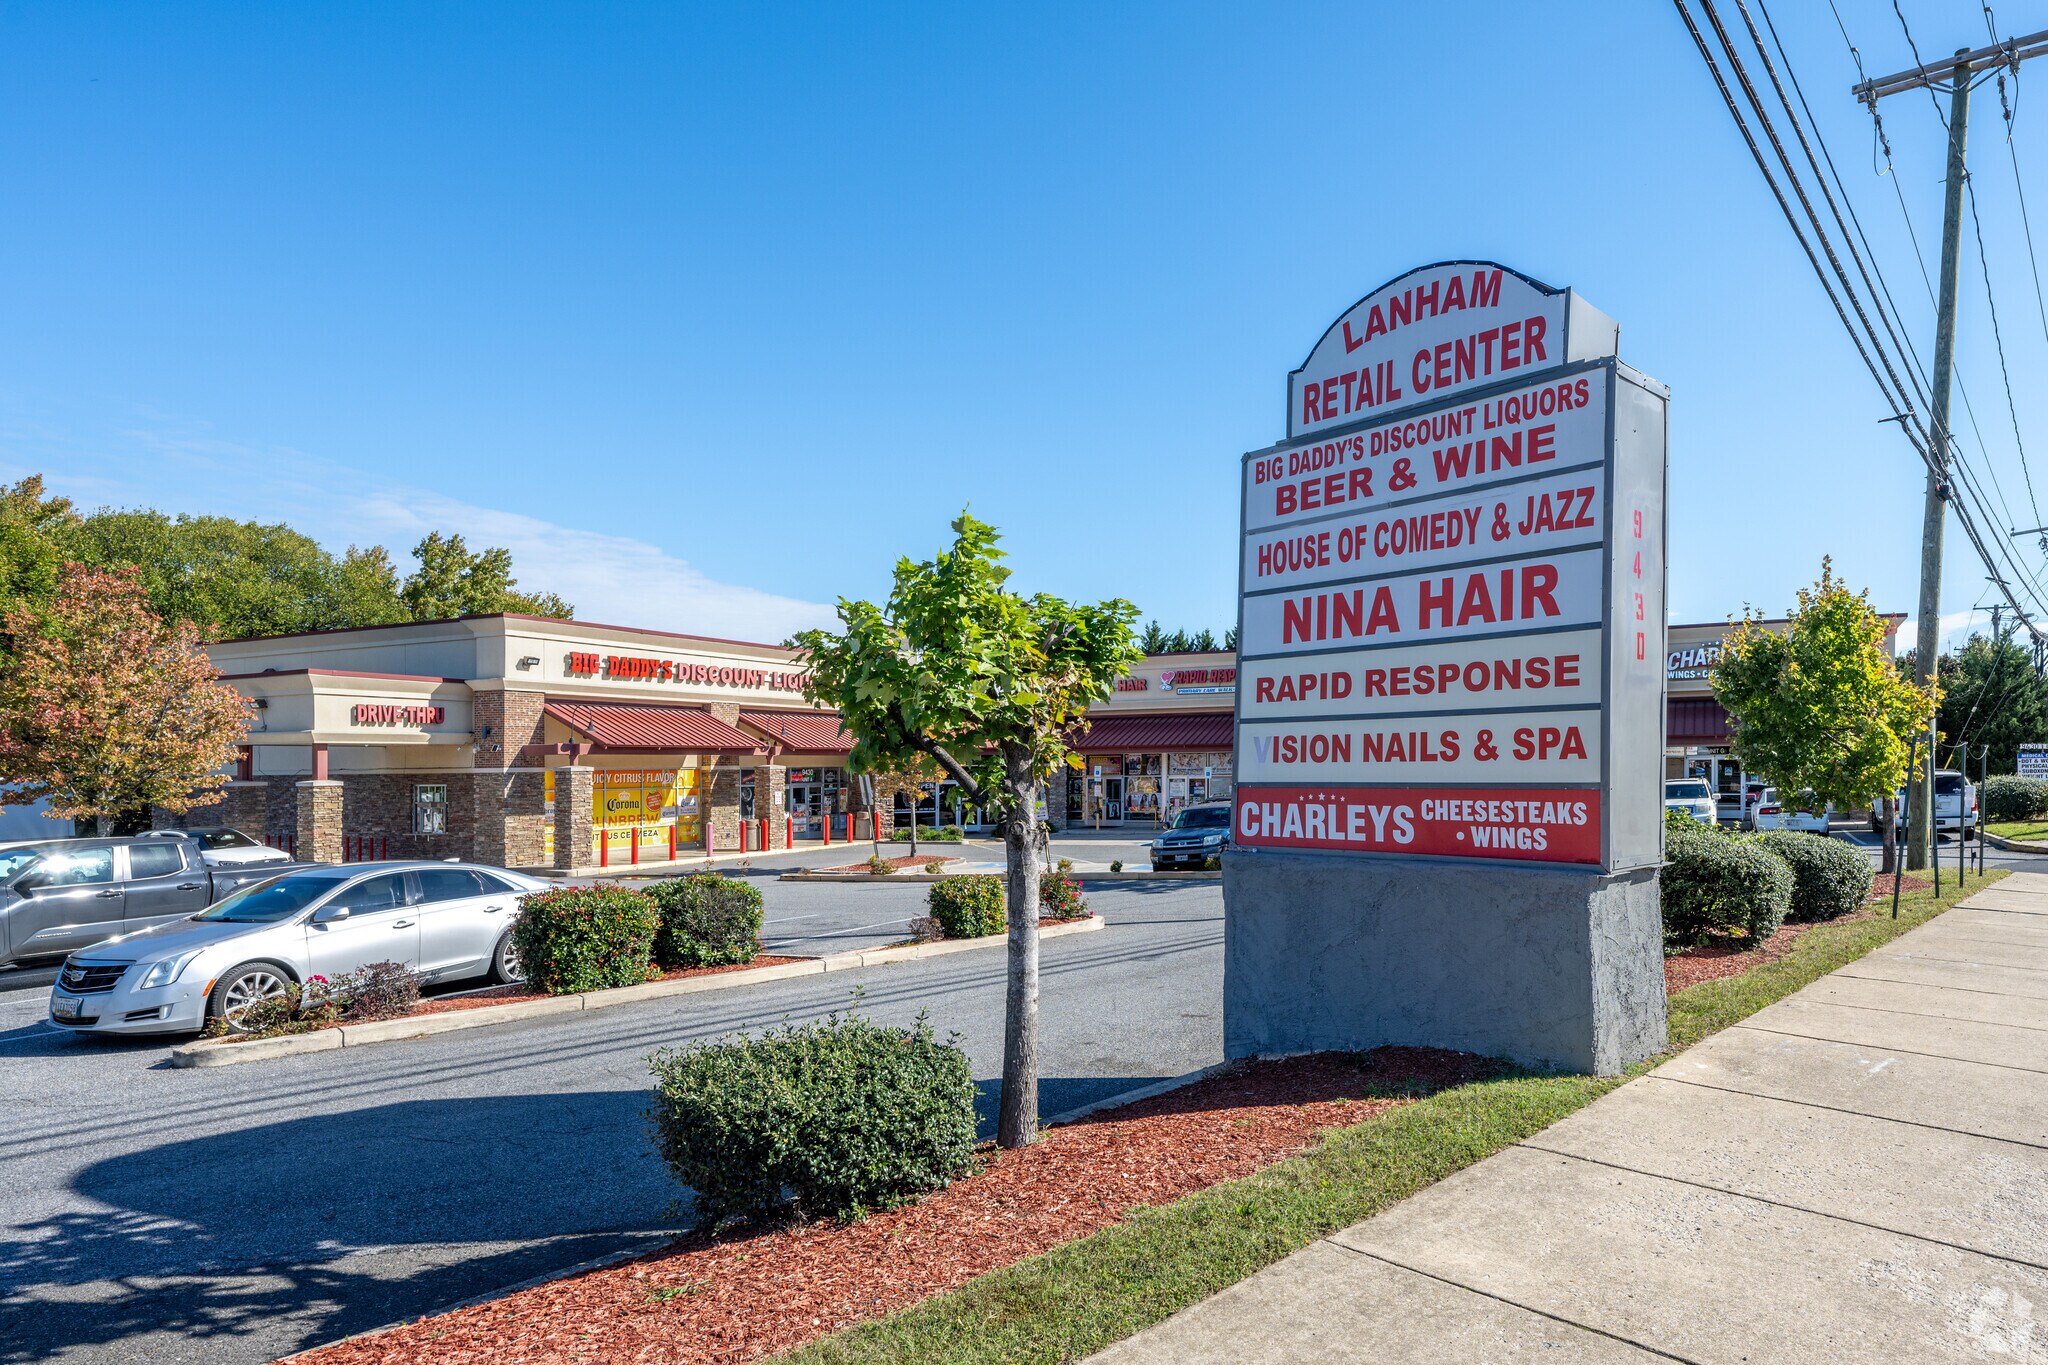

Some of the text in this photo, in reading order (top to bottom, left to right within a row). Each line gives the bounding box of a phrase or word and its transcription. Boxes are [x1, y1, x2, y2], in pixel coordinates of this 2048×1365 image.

[1343, 270, 1503, 354] LANHAM
[1303, 316, 1547, 424] RETAIL CENTER
[1255, 379, 1590, 484] BIG DADDY'S DISCOUNT LIQUORS
[1275, 424, 1556, 516] BEER & WINE
[1258, 486, 1595, 577] HOUSE OF COMEDY & JAZZ
[1283, 564, 1560, 644] NINA HAIR
[571, 651, 813, 691] BIG DADDY'S DISCOUNT LIQU
[1175, 668, 1236, 685] RAPID RESP
[1256, 654, 1580, 703] RAPID RESPONSE
[1667, 647, 1733, 671] CHAR
[1667, 670, 1695, 679] WINGS
[1117, 679, 1147, 692] HAIR
[1253, 726, 1588, 764] VISION NAILS & SPA
[614, 773, 644, 783] CITRUS
[646, 773, 674, 783] FLAVOR
[607, 798, 640, 813] Corona
[1240, 801, 1415, 844] CHARLEYS
[1421, 799, 1587, 825] CHEESESTEAKS
[1470, 826, 1547, 850] WINGS
